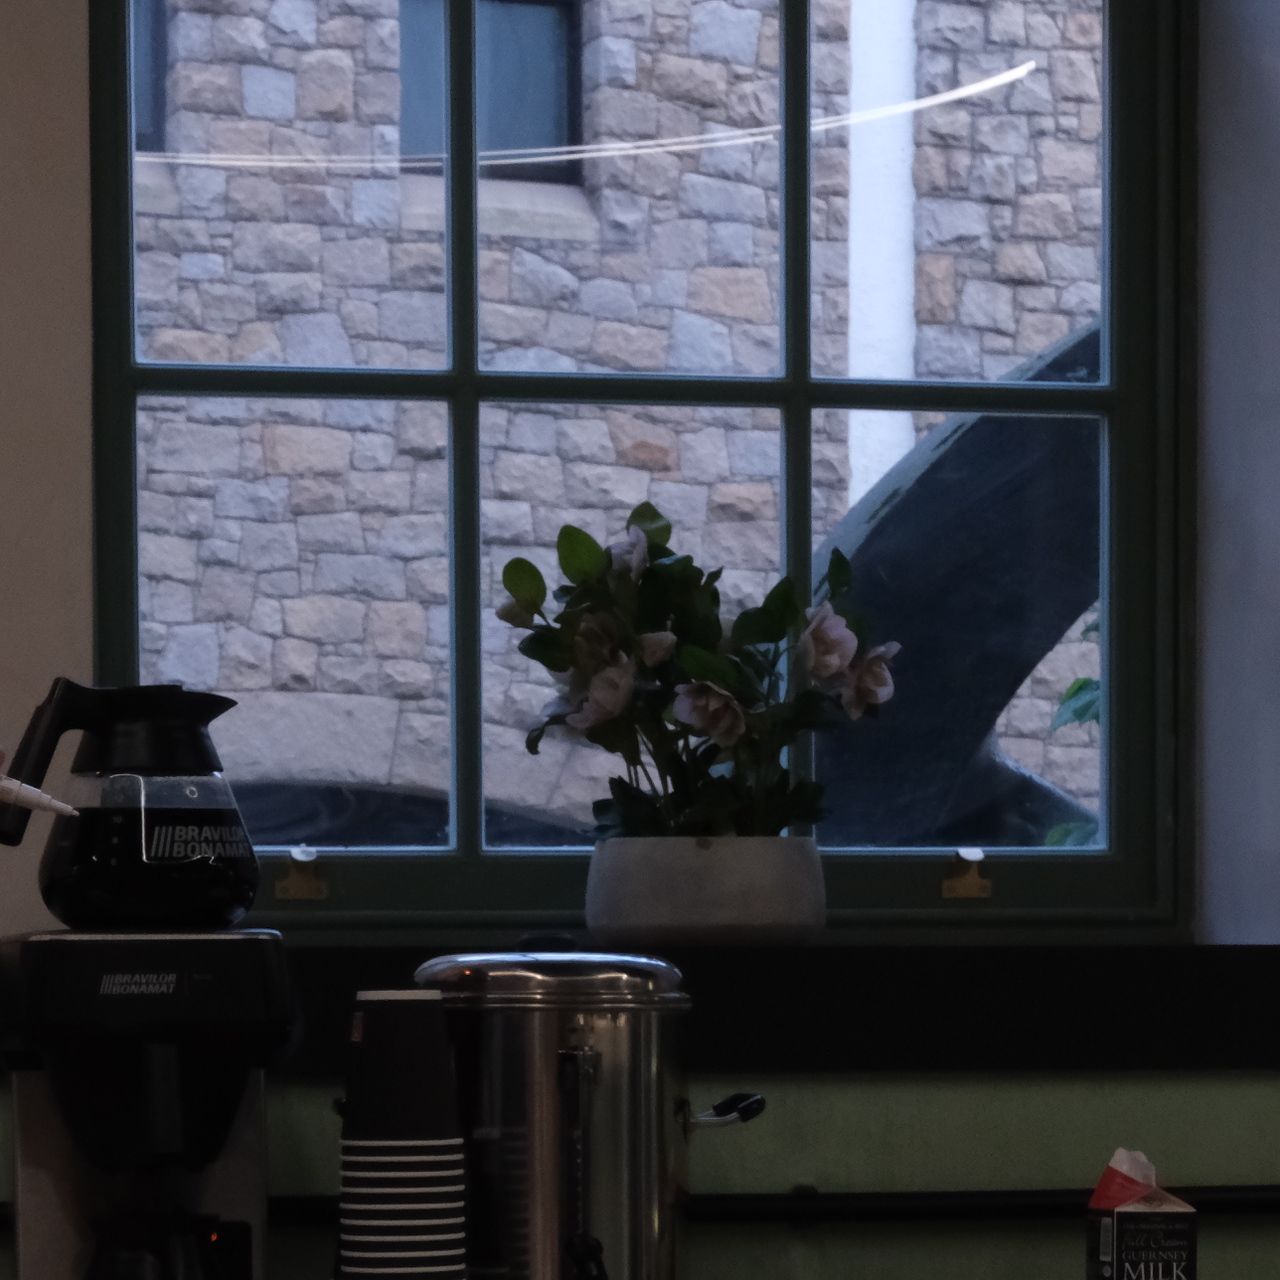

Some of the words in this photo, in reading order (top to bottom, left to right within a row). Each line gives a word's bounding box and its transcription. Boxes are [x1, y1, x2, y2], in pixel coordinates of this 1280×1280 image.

[113, 973, 177, 984] BRAVILOR
[112, 984, 176, 995] BONAMAT
[1121, 1250, 1189, 1261] GUERNSEY
